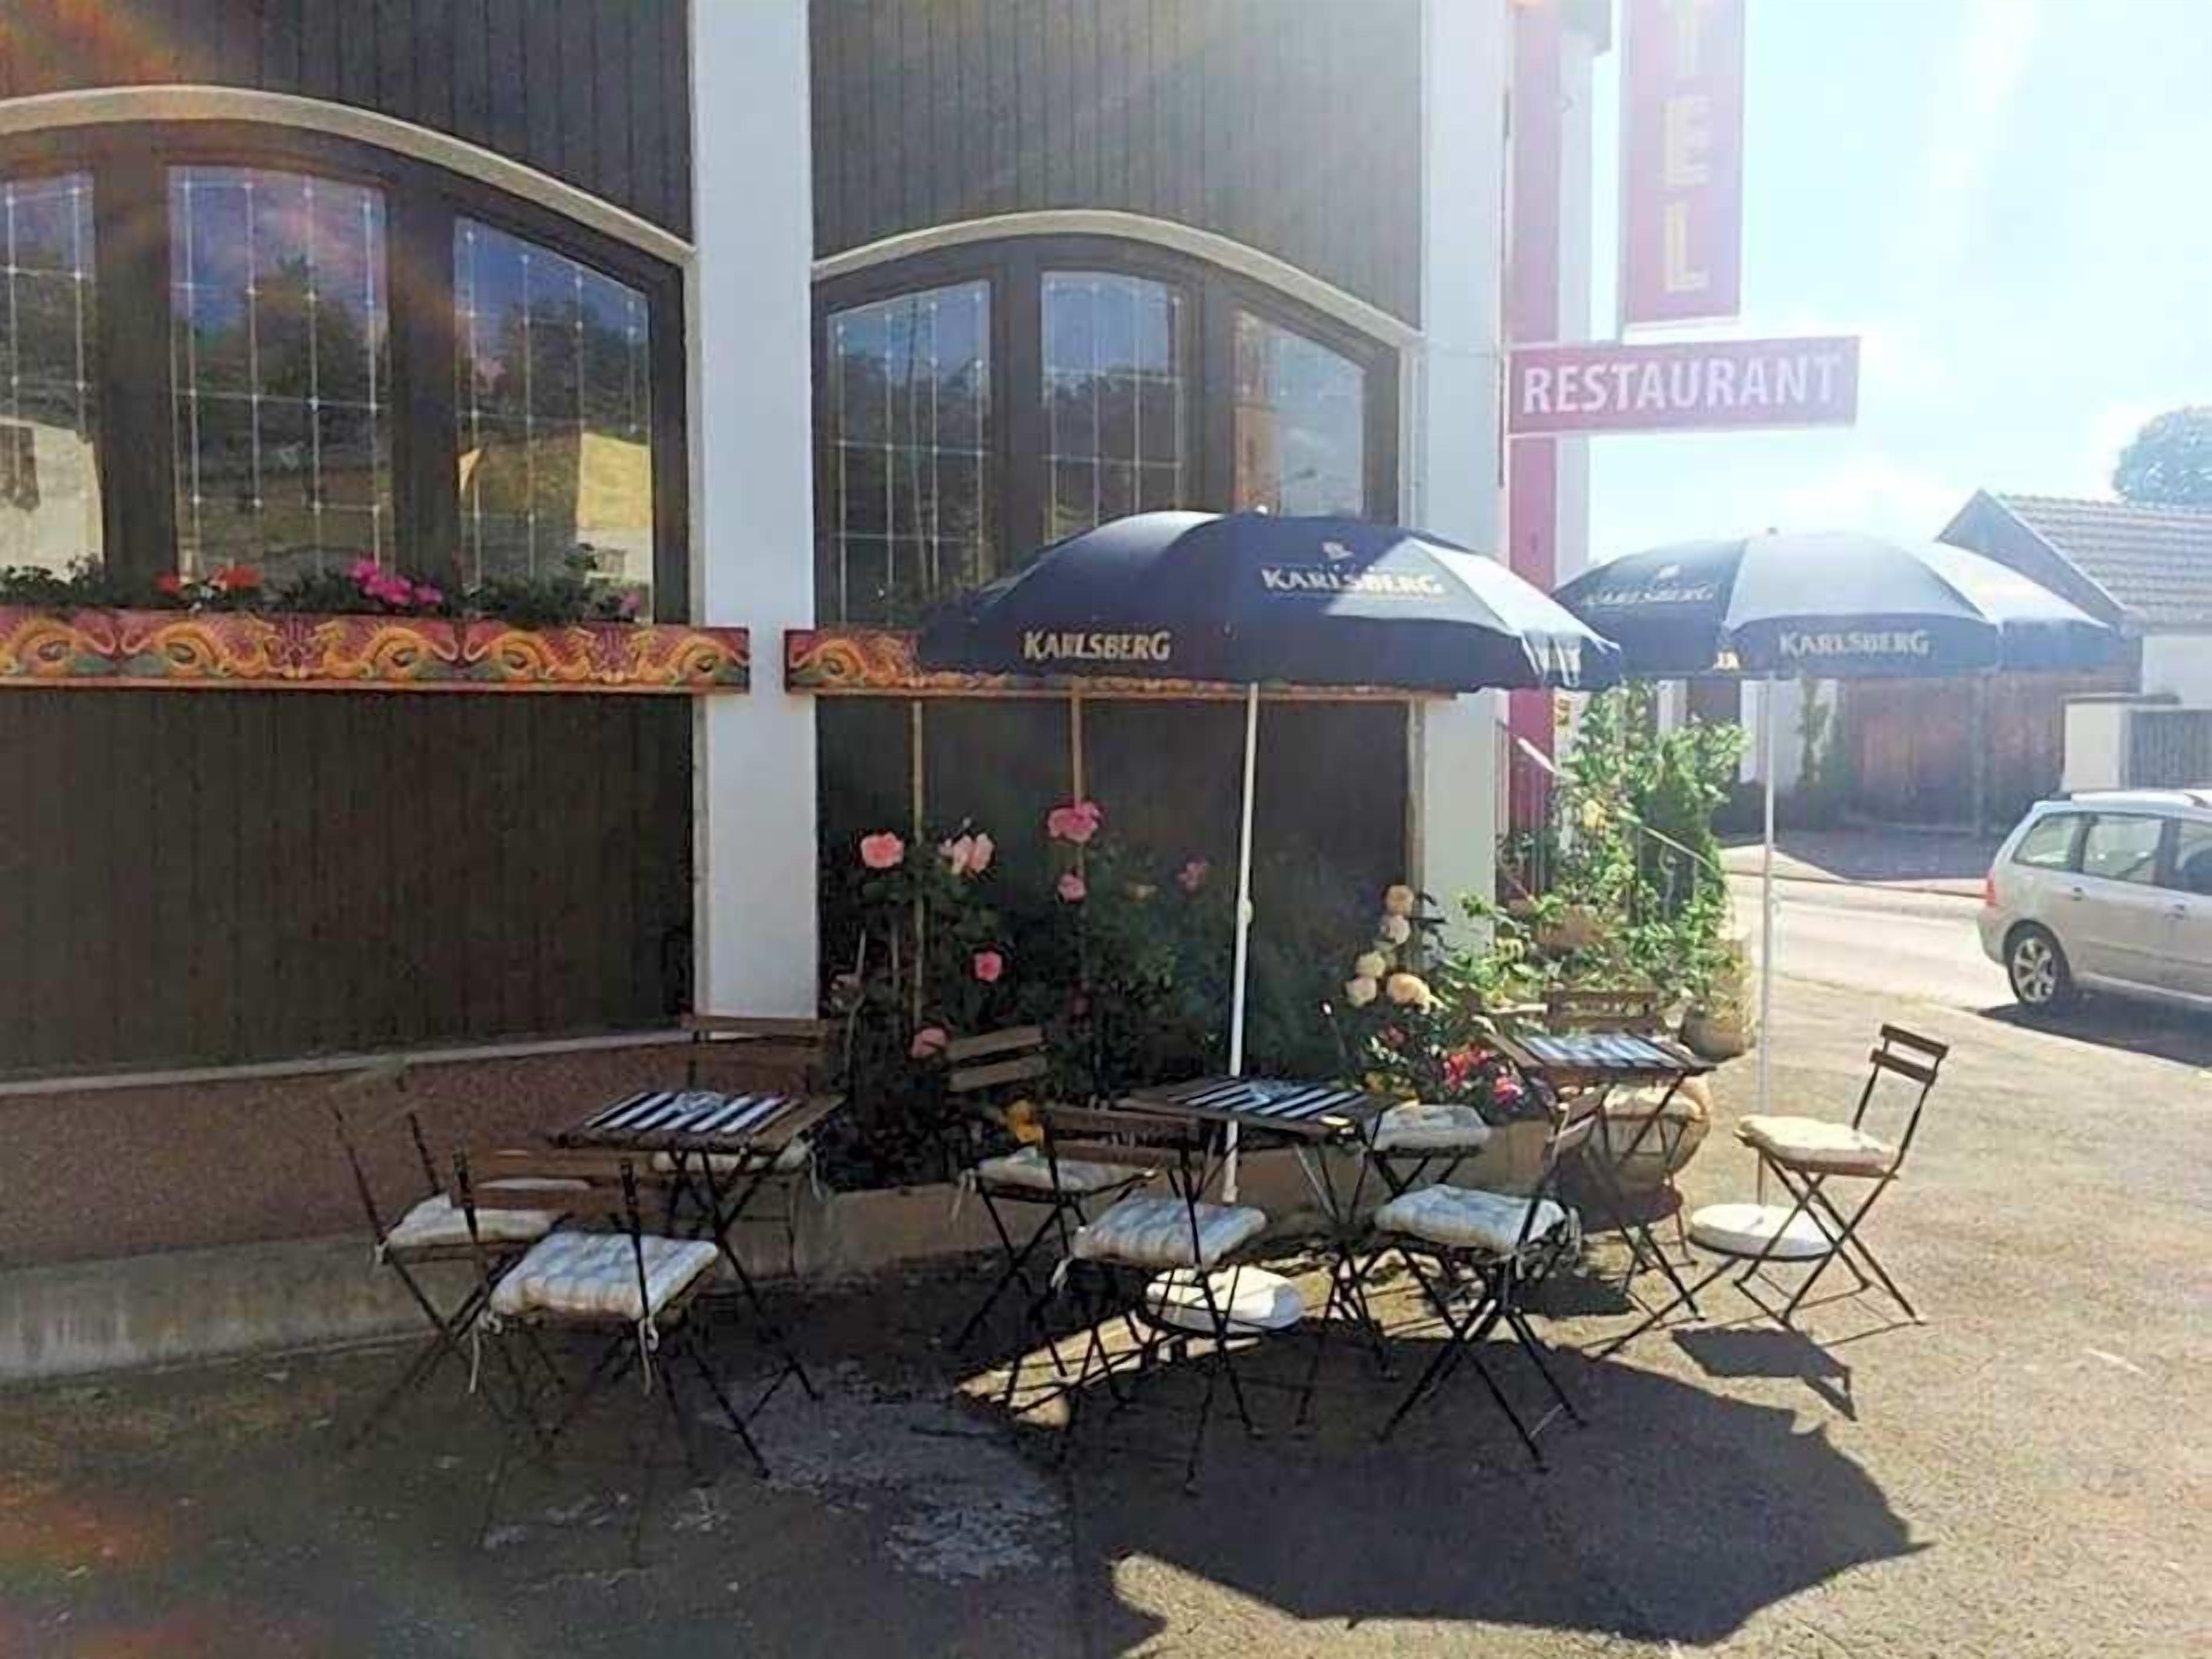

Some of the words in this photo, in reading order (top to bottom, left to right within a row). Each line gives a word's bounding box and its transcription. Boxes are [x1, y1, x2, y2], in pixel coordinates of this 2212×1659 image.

[1523, 355, 1843, 413] RESTAURANT
[1261, 567, 1444, 594] KARLSBERG
[1024, 630, 1171, 661] KARLSBERG
[1778, 630, 1930, 658] KARLSBERG
